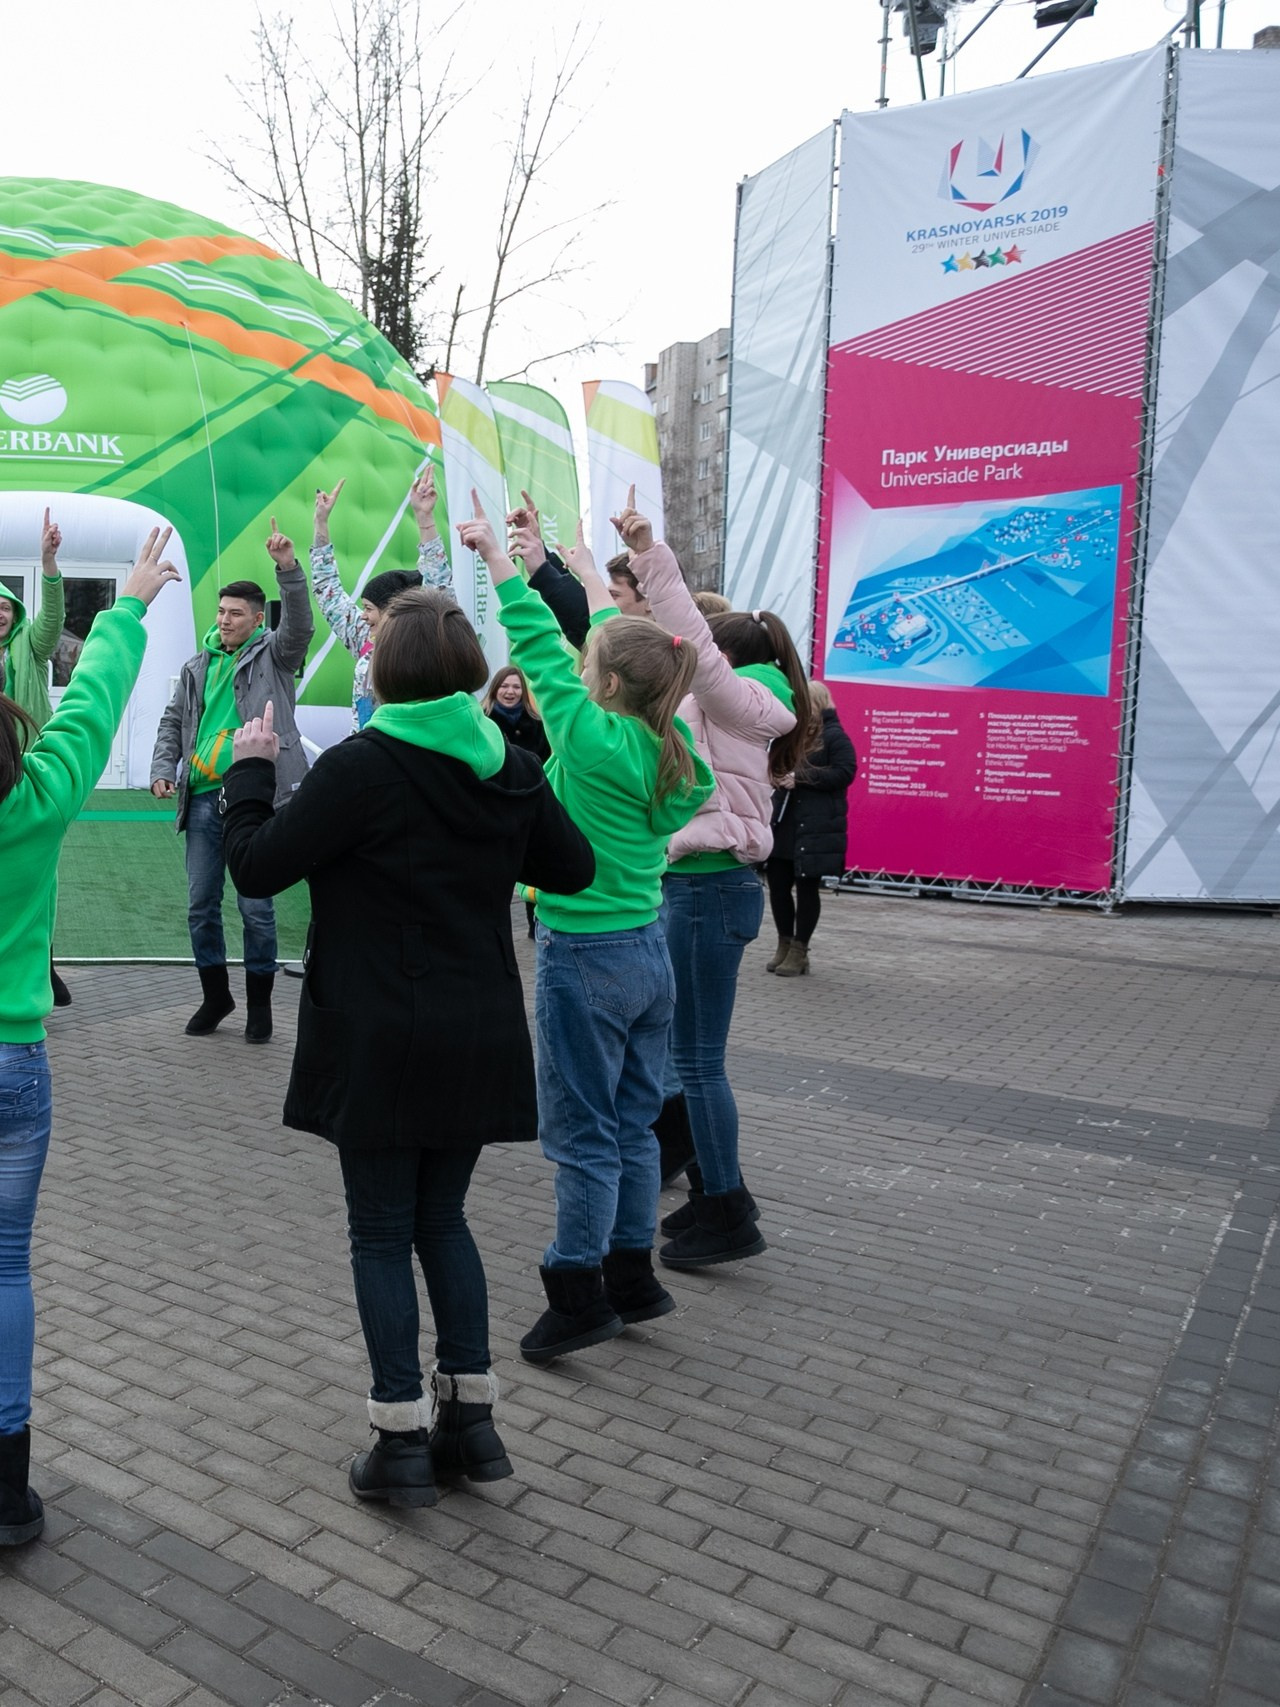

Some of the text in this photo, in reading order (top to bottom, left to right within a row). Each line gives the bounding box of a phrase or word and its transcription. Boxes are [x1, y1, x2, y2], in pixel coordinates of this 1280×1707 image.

[906, 205, 1068, 242] KRASNOYARSK 2019
[937, 235, 980, 250] WINTER
[983, 222, 1061, 243] UNIVERSIADE
[881, 439, 1069, 468] Парк Универсиады
[880, 462, 1023, 488] Universiade Park
